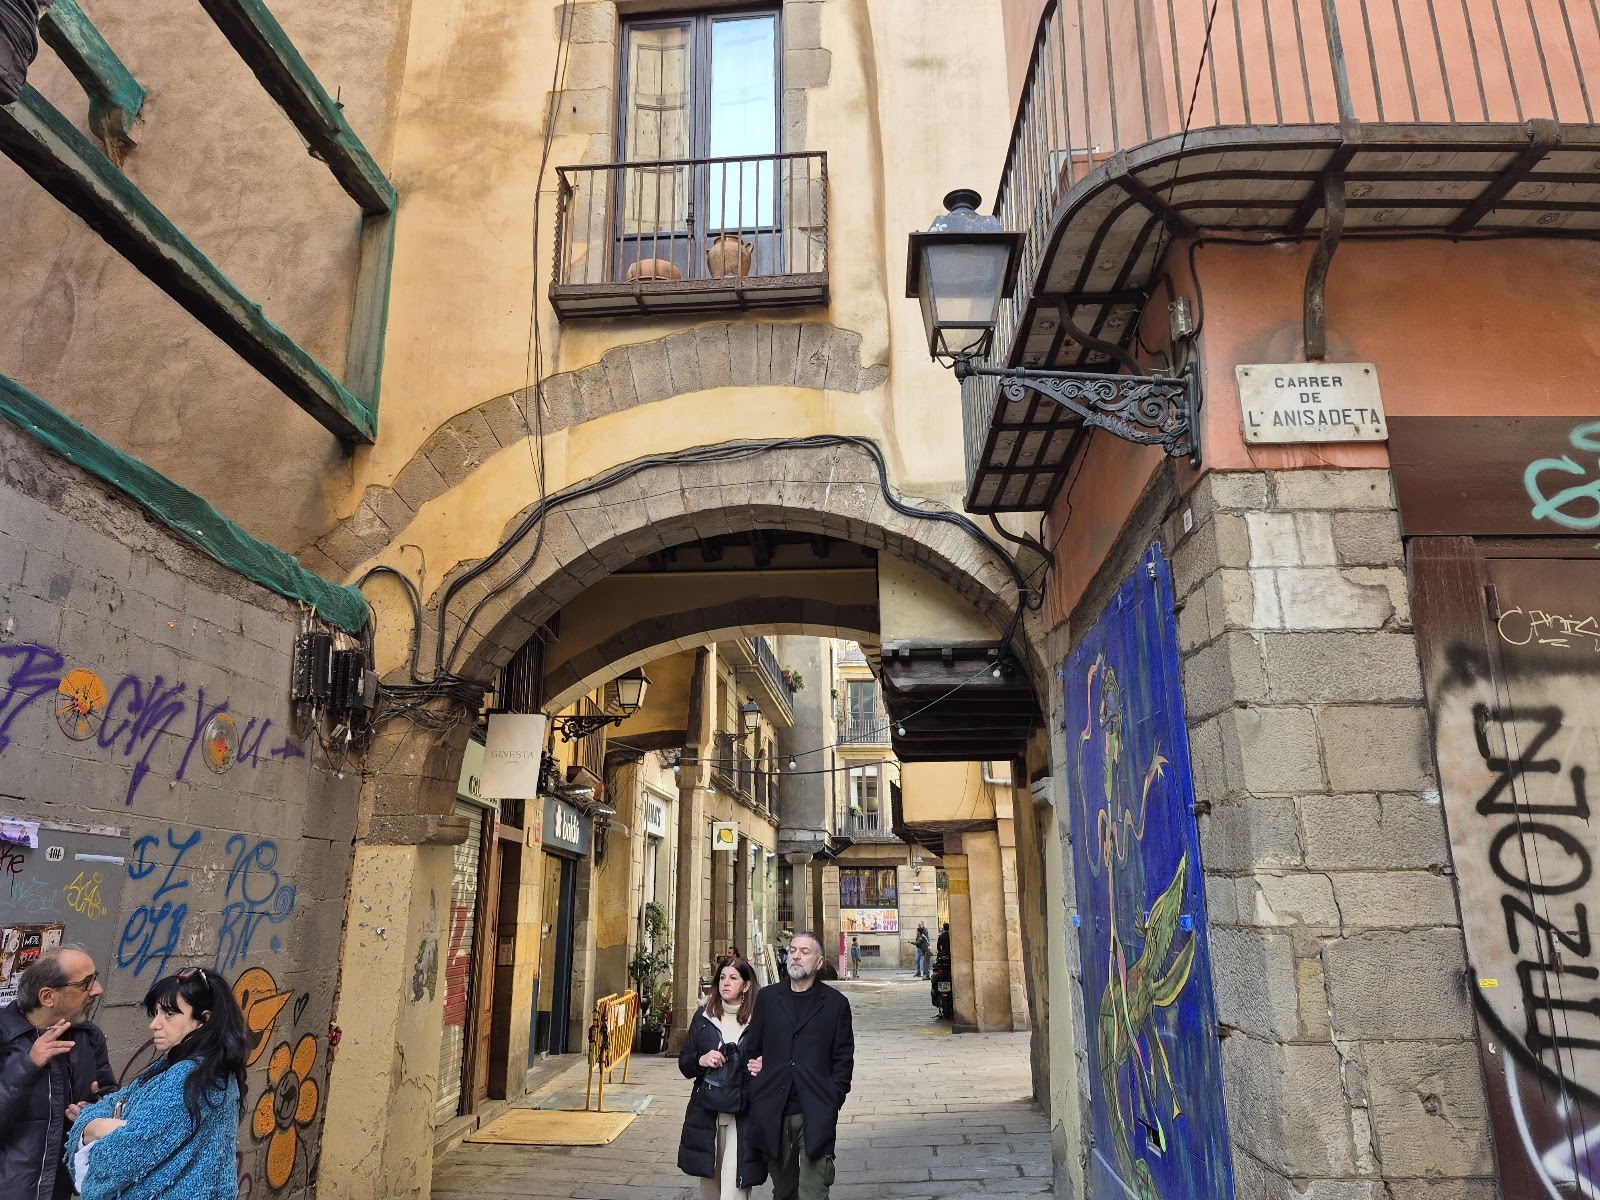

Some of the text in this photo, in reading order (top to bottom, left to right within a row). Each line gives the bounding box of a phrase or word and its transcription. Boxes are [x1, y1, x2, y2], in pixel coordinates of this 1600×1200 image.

[1274, 376, 1343, 388] CARRER
[1299, 392, 1322, 404] DE
[1272, 408, 1381, 427] ANISADETA
[491, 750, 534, 759] GINESTA
